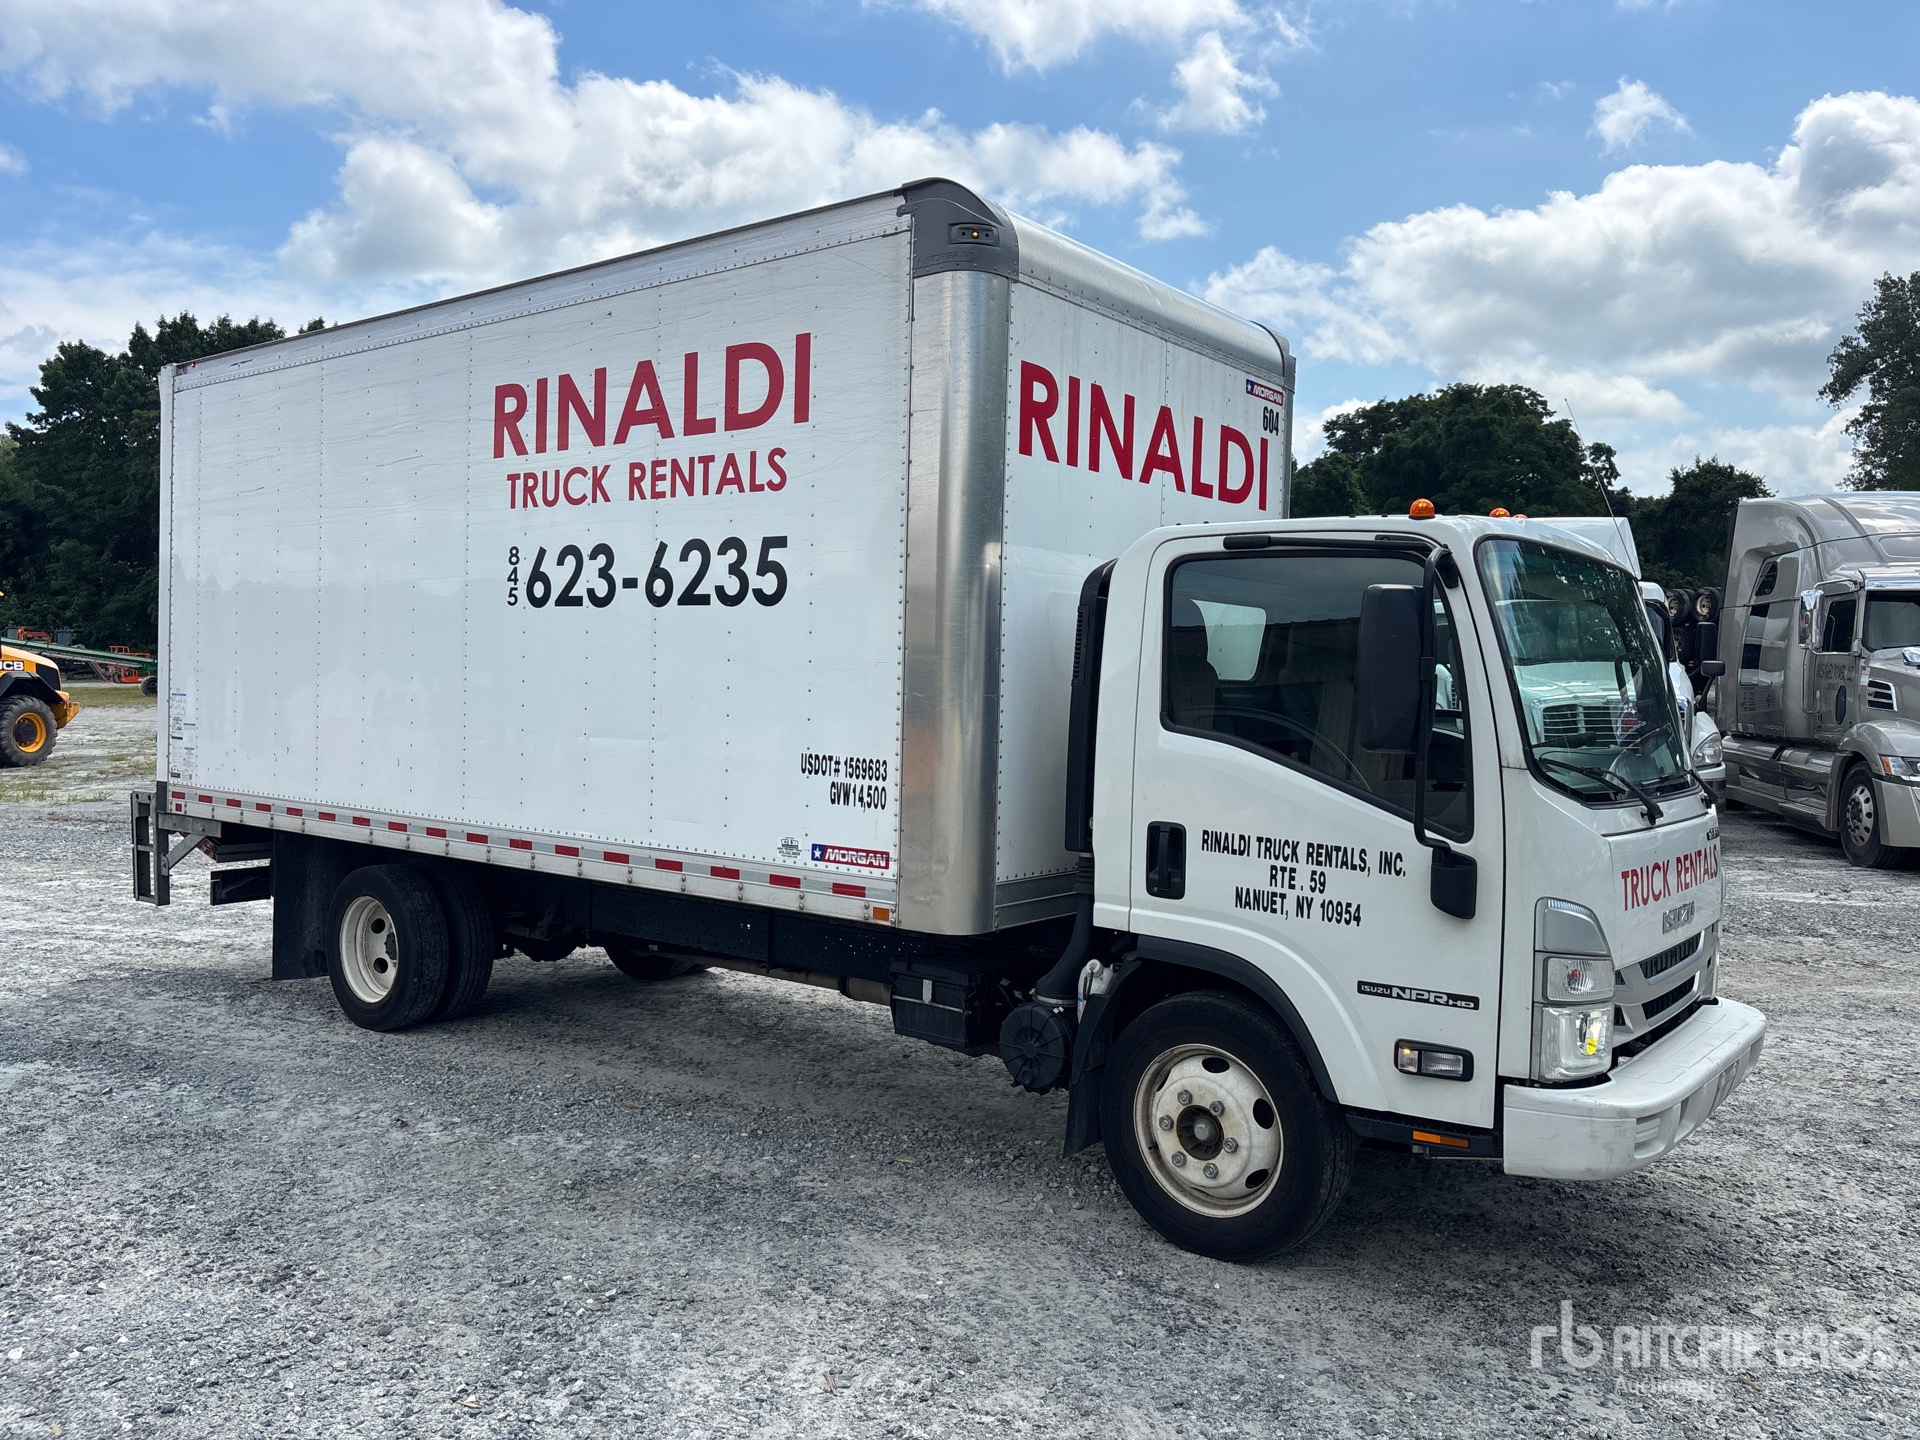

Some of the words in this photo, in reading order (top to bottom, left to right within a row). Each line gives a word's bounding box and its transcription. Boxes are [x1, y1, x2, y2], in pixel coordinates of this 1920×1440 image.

[493, 332, 812, 459] RINALDI
[1252, 384, 1283, 404] MORGAN
[1018, 360, 1269, 511] RINALDI
[1262, 405, 1280, 436] 604
[506, 464, 612, 510] TRUCK
[627, 447, 788, 502] RENTALS
[525, 535, 789, 609] 623-6235
[0, 661, 24, 671] CB
[800, 752, 842, 777] USDOT#
[843, 756, 888, 782] 1569683
[824, 848, 887, 867] MORGAN
[1201, 829, 1252, 858] RINALDI
[1256, 836, 1300, 865] TRUCK
[1305, 842, 1372, 877] RENTALS,
[1378, 850, 1407, 877] INC.
[1309, 870, 1327, 895] 59
[1620, 859, 1671, 912] TRUCK
[1675, 843, 1719, 894] RENTALS
[1234, 886, 1289, 920] NANUET,
[1295, 895, 1314, 919] NY
[1320, 898, 1362, 927] 10954
[1361, 984, 1391, 995] ISUZU
[1391, 986, 1448, 1005] NPR
[1448, 998, 1475, 1009] HD
